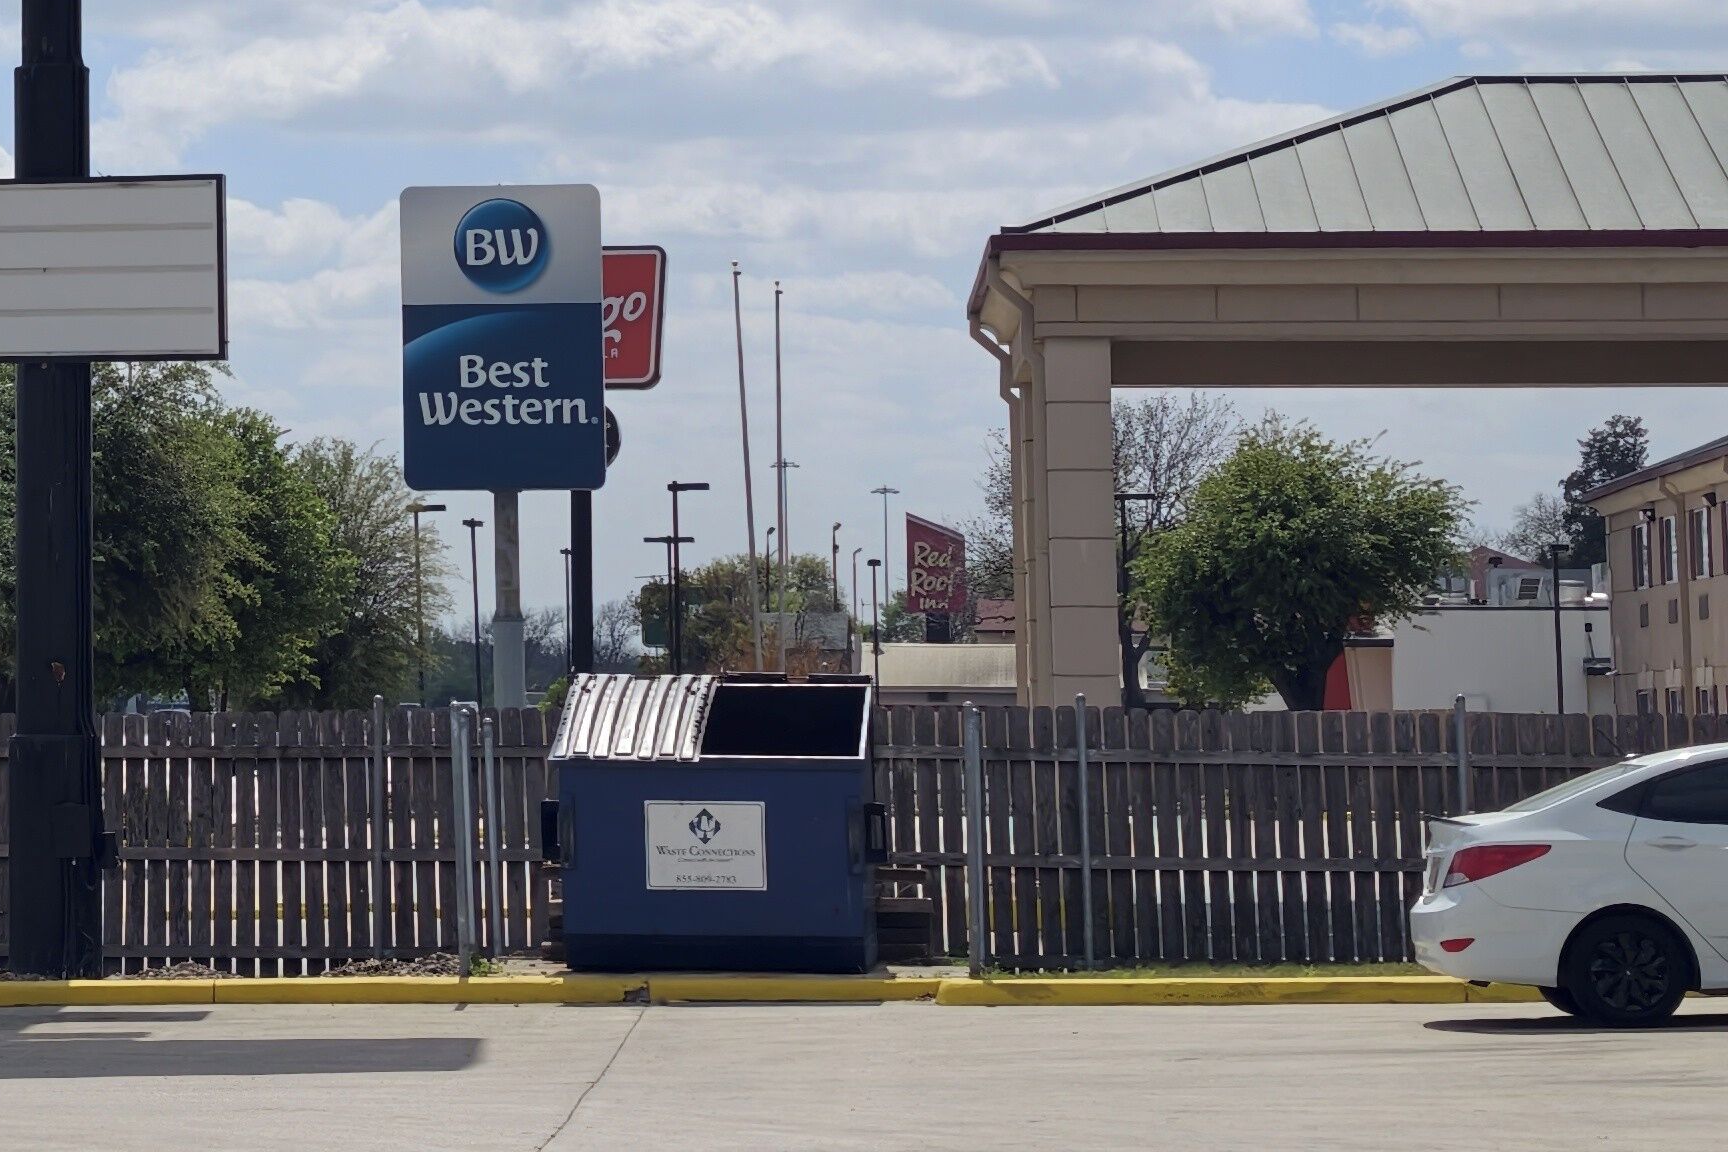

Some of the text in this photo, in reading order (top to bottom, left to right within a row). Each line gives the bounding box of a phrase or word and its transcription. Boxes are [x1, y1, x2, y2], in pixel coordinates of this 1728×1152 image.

[465, 227, 540, 267] BW
[459, 354, 550, 388] Best
[418, 391, 589, 426] Western
[913, 541, 954, 568] Red
[910, 567, 964, 597] Roof
[656, 845, 687, 856] WASTE
